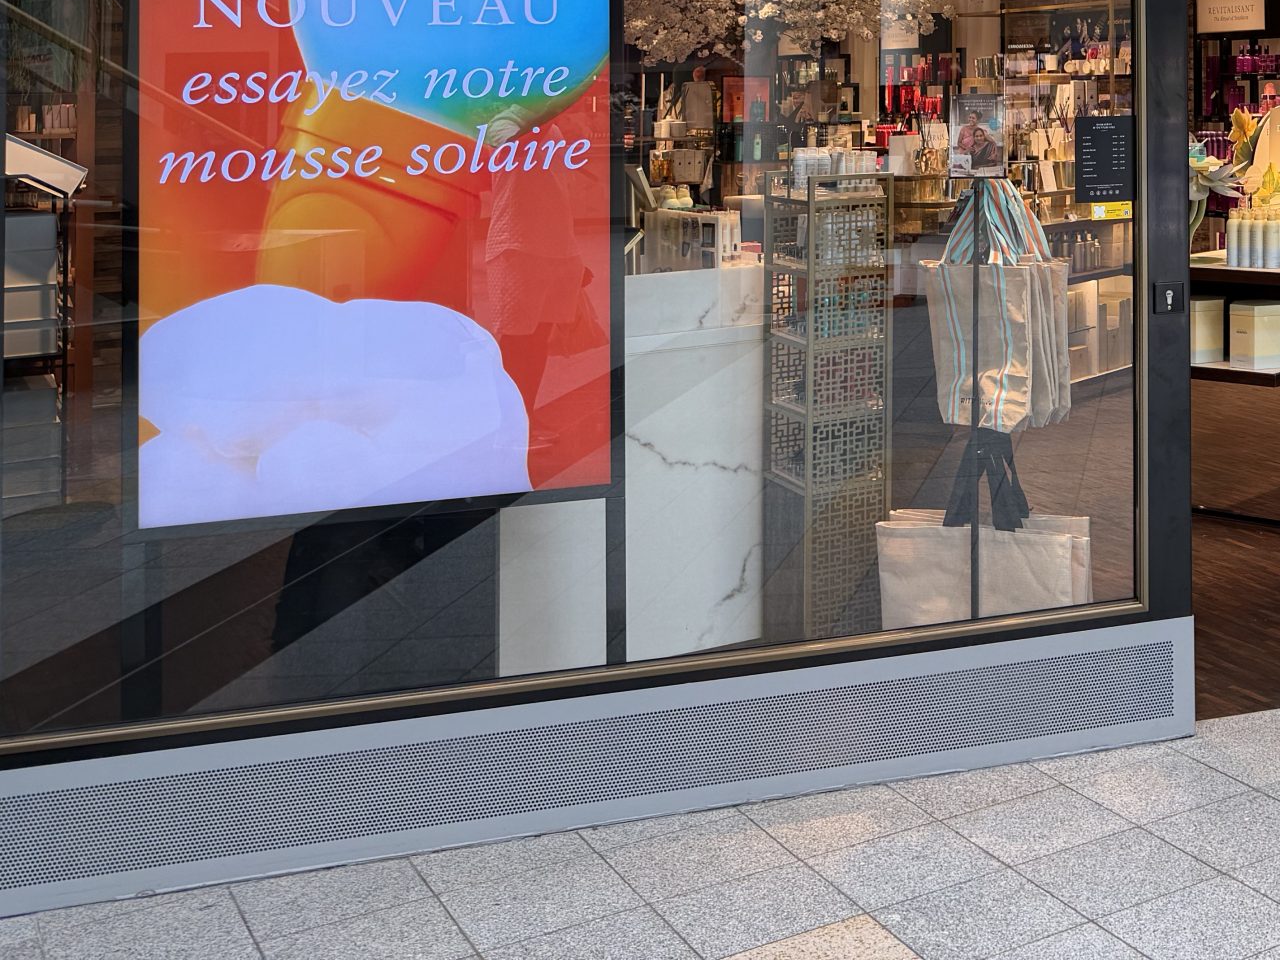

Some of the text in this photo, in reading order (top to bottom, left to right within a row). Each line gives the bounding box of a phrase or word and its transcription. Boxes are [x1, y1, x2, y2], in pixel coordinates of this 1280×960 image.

[182, 60, 570, 116] essayez notre
[159, 125, 592, 184] mousse solaire
